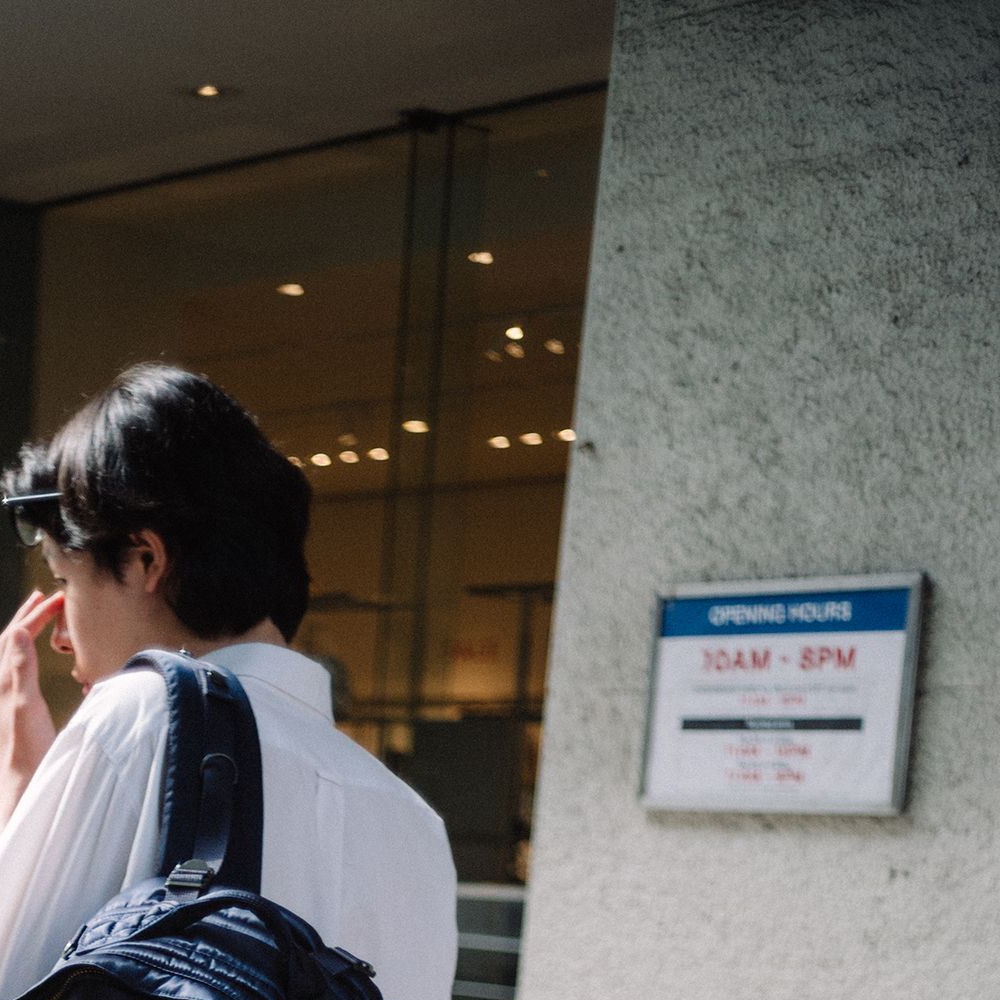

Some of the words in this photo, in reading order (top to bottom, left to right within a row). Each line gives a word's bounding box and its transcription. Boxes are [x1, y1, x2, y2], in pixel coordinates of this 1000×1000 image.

[708, 603, 785, 626] OPENING
[788, 601, 852, 623] HOURS
[702, 648, 771, 672] 10AM
